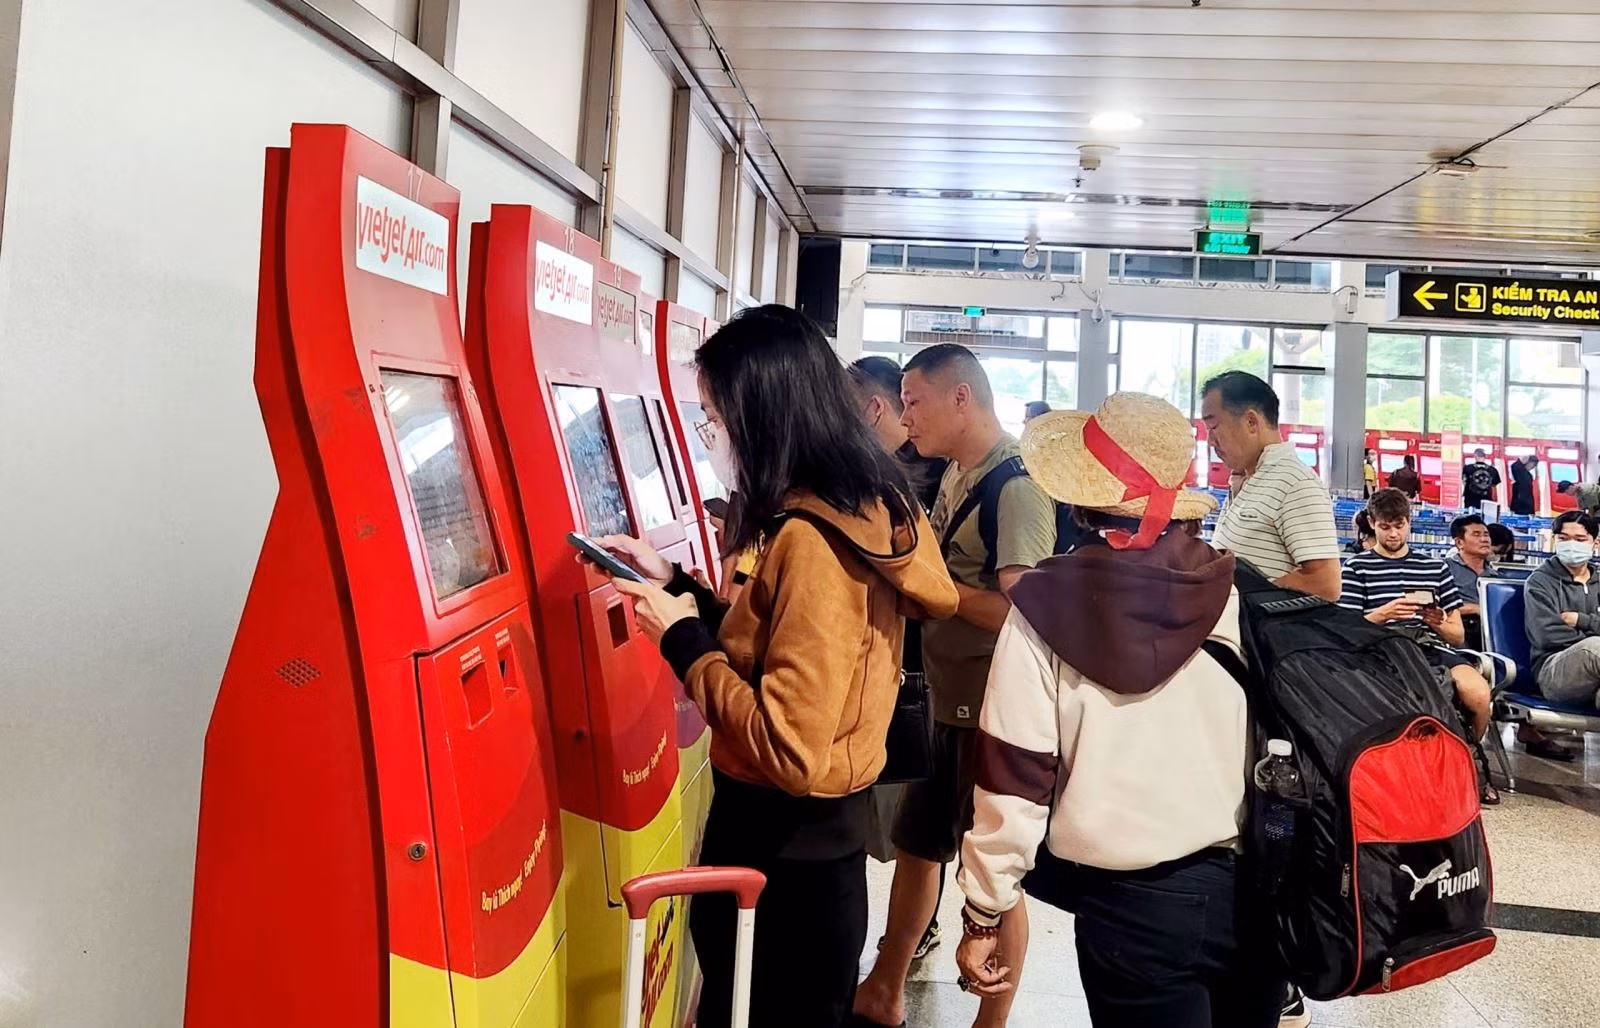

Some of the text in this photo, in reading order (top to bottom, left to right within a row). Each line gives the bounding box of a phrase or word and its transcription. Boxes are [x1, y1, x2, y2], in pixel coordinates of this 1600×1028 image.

[408, 164, 424, 202] 17
[1536, 288, 1571, 303] TRA
[1573, 290, 1598, 305] AN
[1492, 302, 1600, 320] Security Check
[1437, 866, 1480, 900] PUMA
